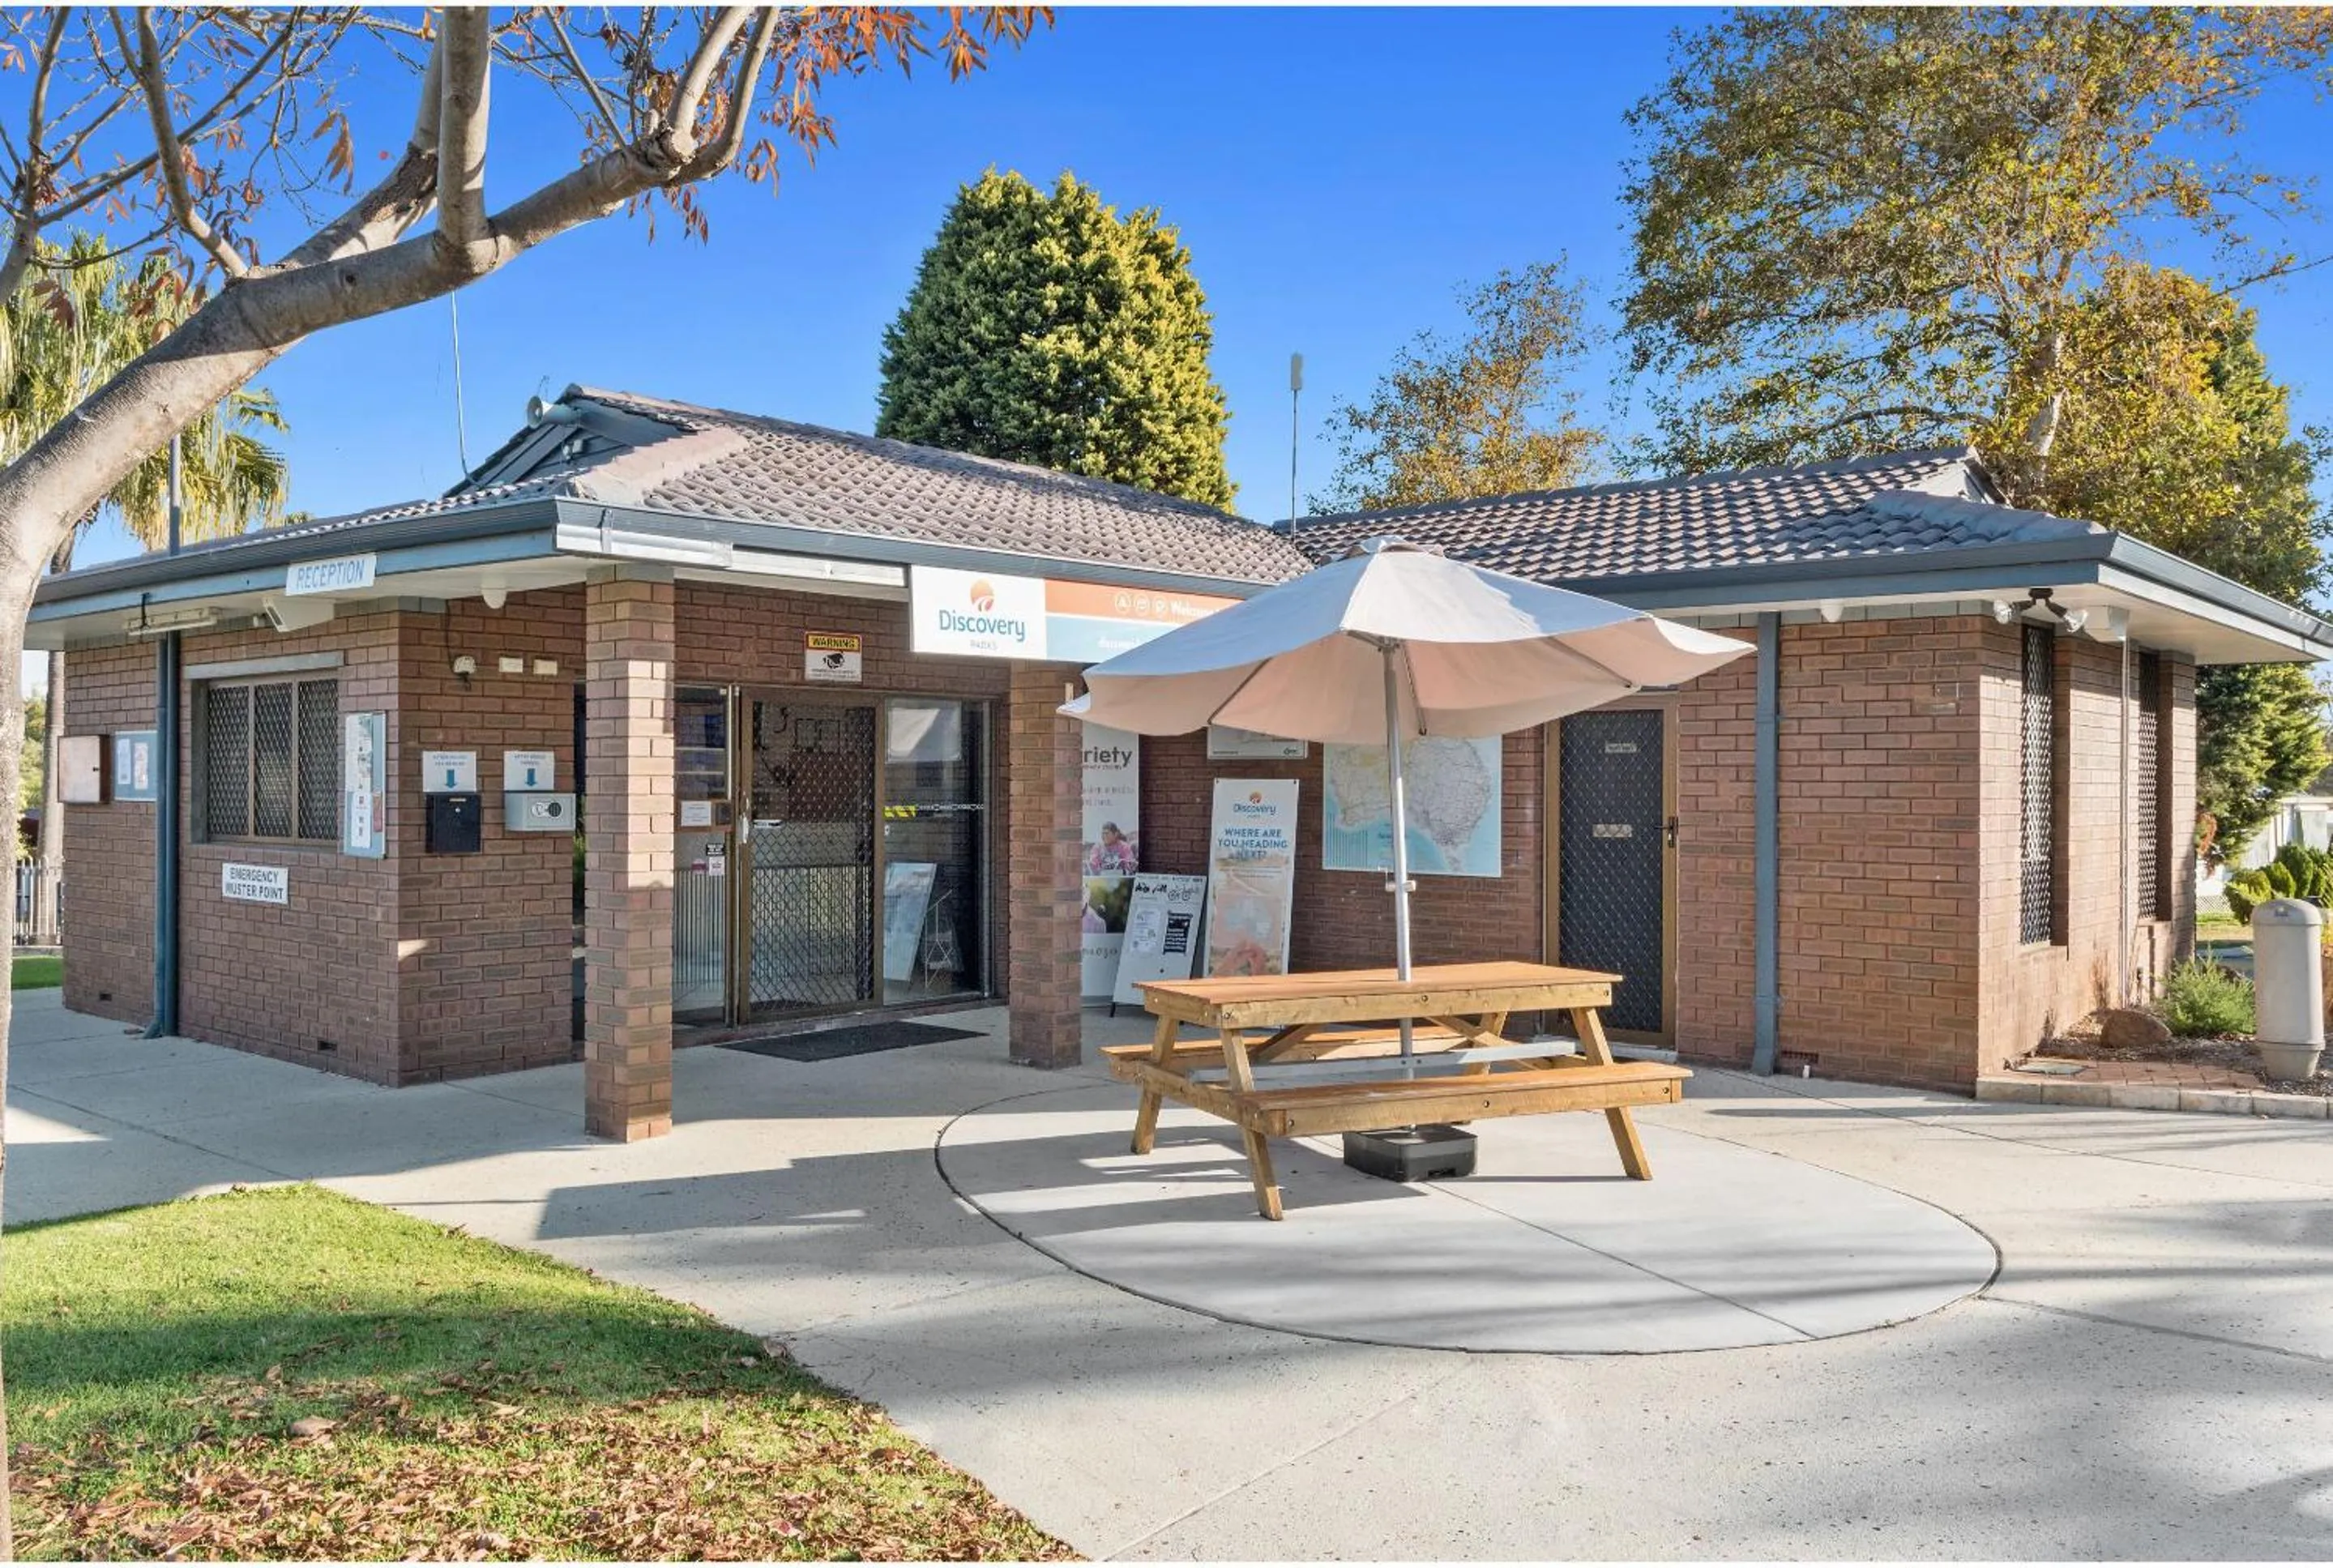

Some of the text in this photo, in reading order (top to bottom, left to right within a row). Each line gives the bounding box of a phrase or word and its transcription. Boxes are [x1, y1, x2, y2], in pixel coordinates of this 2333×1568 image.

[297, 558, 365, 590] RECEPTION
[938, 609, 1025, 643] Discovery
[811, 637, 856, 648] WARNING
[1083, 746, 1133, 768] riety
[1225, 827, 1282, 838] WHERE ARE
[1218, 839, 1288, 848] YOU HEADING
[230, 867, 279, 883] EMERGENCY
[226, 882, 284, 899] MUSTER POINT
